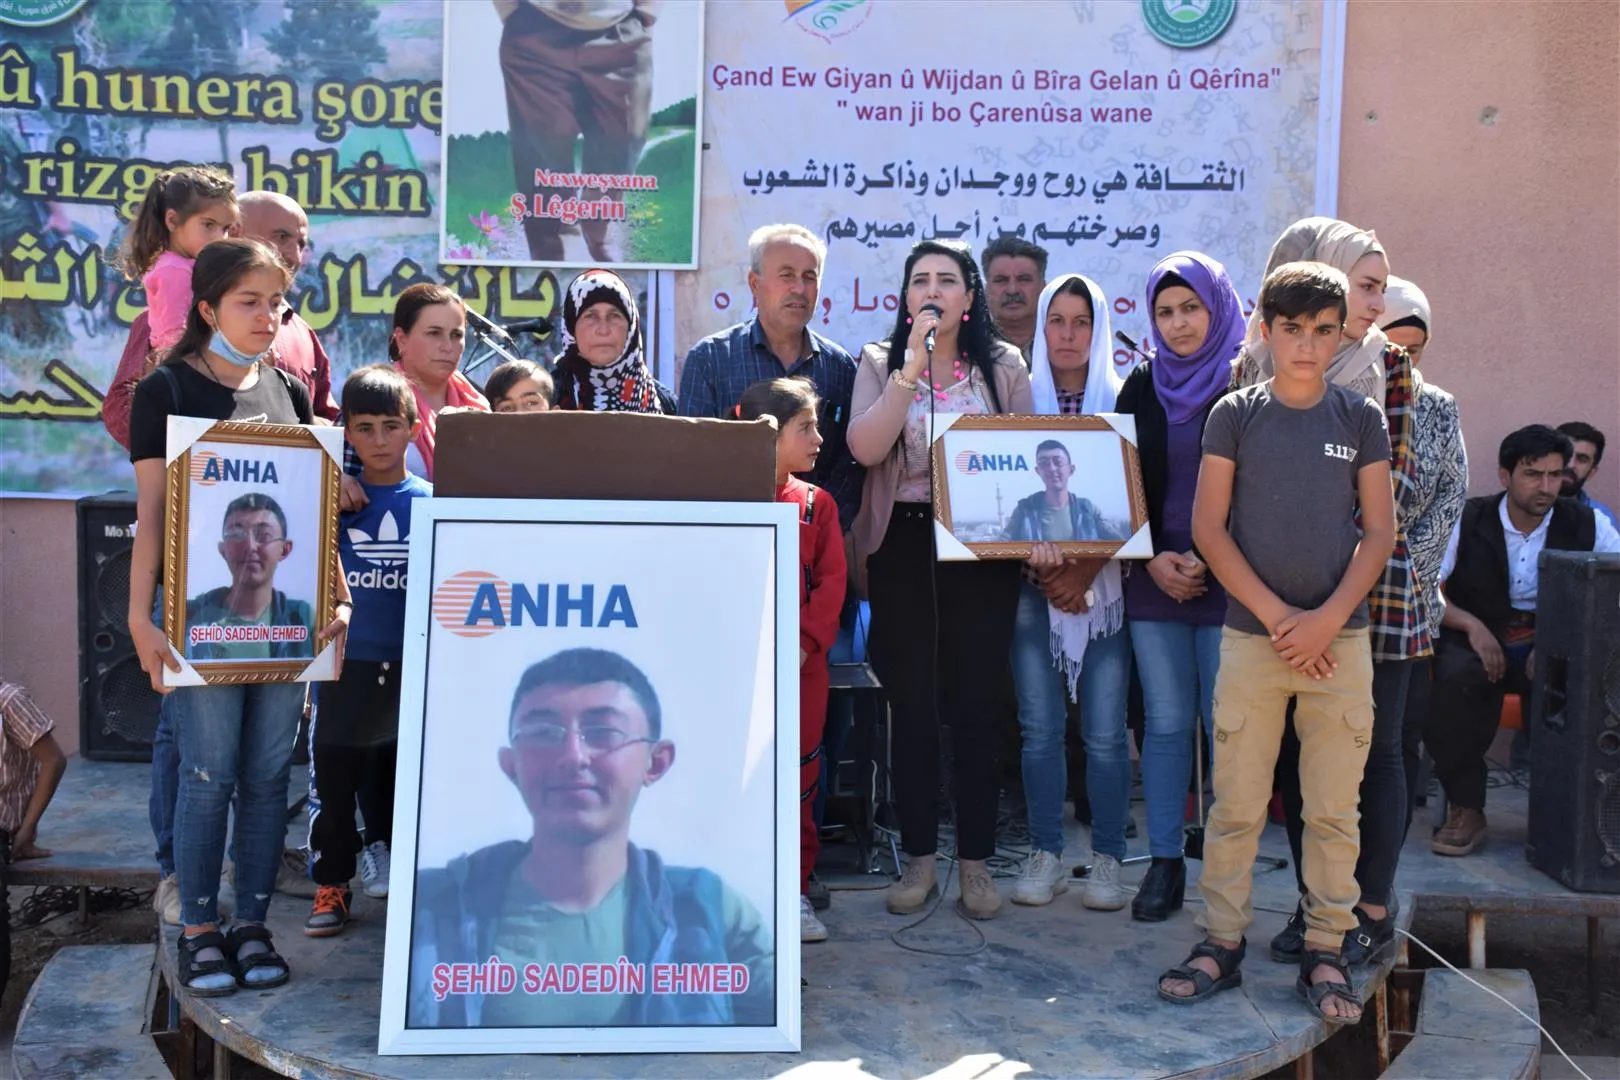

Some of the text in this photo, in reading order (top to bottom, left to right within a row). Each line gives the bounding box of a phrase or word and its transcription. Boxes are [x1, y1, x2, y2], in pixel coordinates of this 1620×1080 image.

[57, 51, 296, 120] hunera
[318, 79, 441, 137] şore
[712, 65, 773, 90] Çand
[782, 66, 816, 87] Ew
[824, 67, 892, 93] Giyan
[901, 69, 914, 88] û
[922, 69, 1001, 94] Wijdan
[1011, 70, 1025, 90] û
[1034, 70, 1081, 90] Bîra
[1090, 70, 1157, 90] Gelan
[1167, 69, 1180, 90] û
[856, 104, 902, 121] wan
[909, 101, 923, 127] ji
[932, 101, 960, 122] bo
[969, 102, 1082, 126] Çarenûsa
[1090, 103, 1152, 122] wane
[23, 142, 427, 220] rizg bikin
[534, 168, 659, 193] Nexweşxana
[743, 158, 1244, 204] الثقافة هي روح ووجدان وذاكرة الشعوب
[826, 216, 915, 248] مصيرهم
[203, 457, 279, 484] ANHA
[968, 454, 1029, 471] ANHA
[464, 582, 639, 629] ANHA
[191, 625, 307, 645] ŞEHÎD SADEDÎN EHMED
[433, 956, 749, 1000] ŞEHÎD SADEDÎN EHMED
